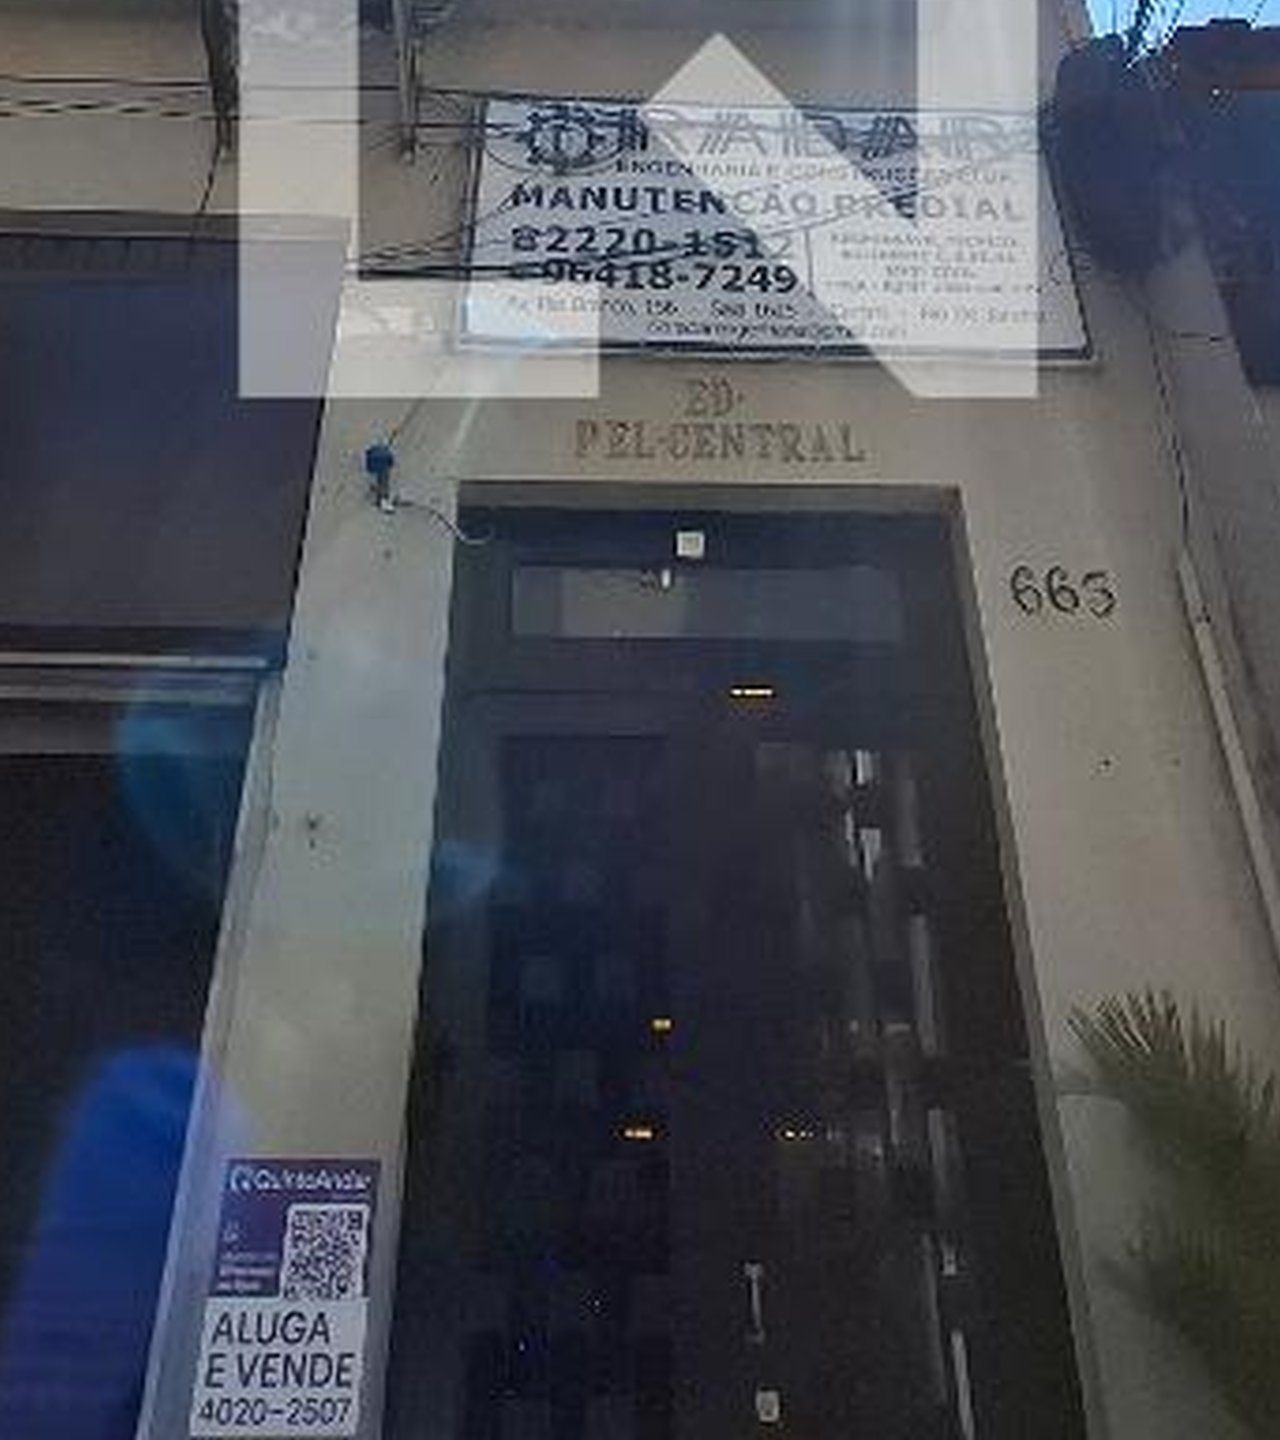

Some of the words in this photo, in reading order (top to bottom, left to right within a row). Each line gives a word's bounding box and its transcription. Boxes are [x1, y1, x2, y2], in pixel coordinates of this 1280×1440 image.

[510, 182, 817, 217] MANUTENÇÃO
[211, 1311, 331, 1344] ALUGA
[204, 1352, 227, 1388] E
[236, 1352, 356, 1389] VENDE
[199, 1397, 353, 1427] 4020-2507
